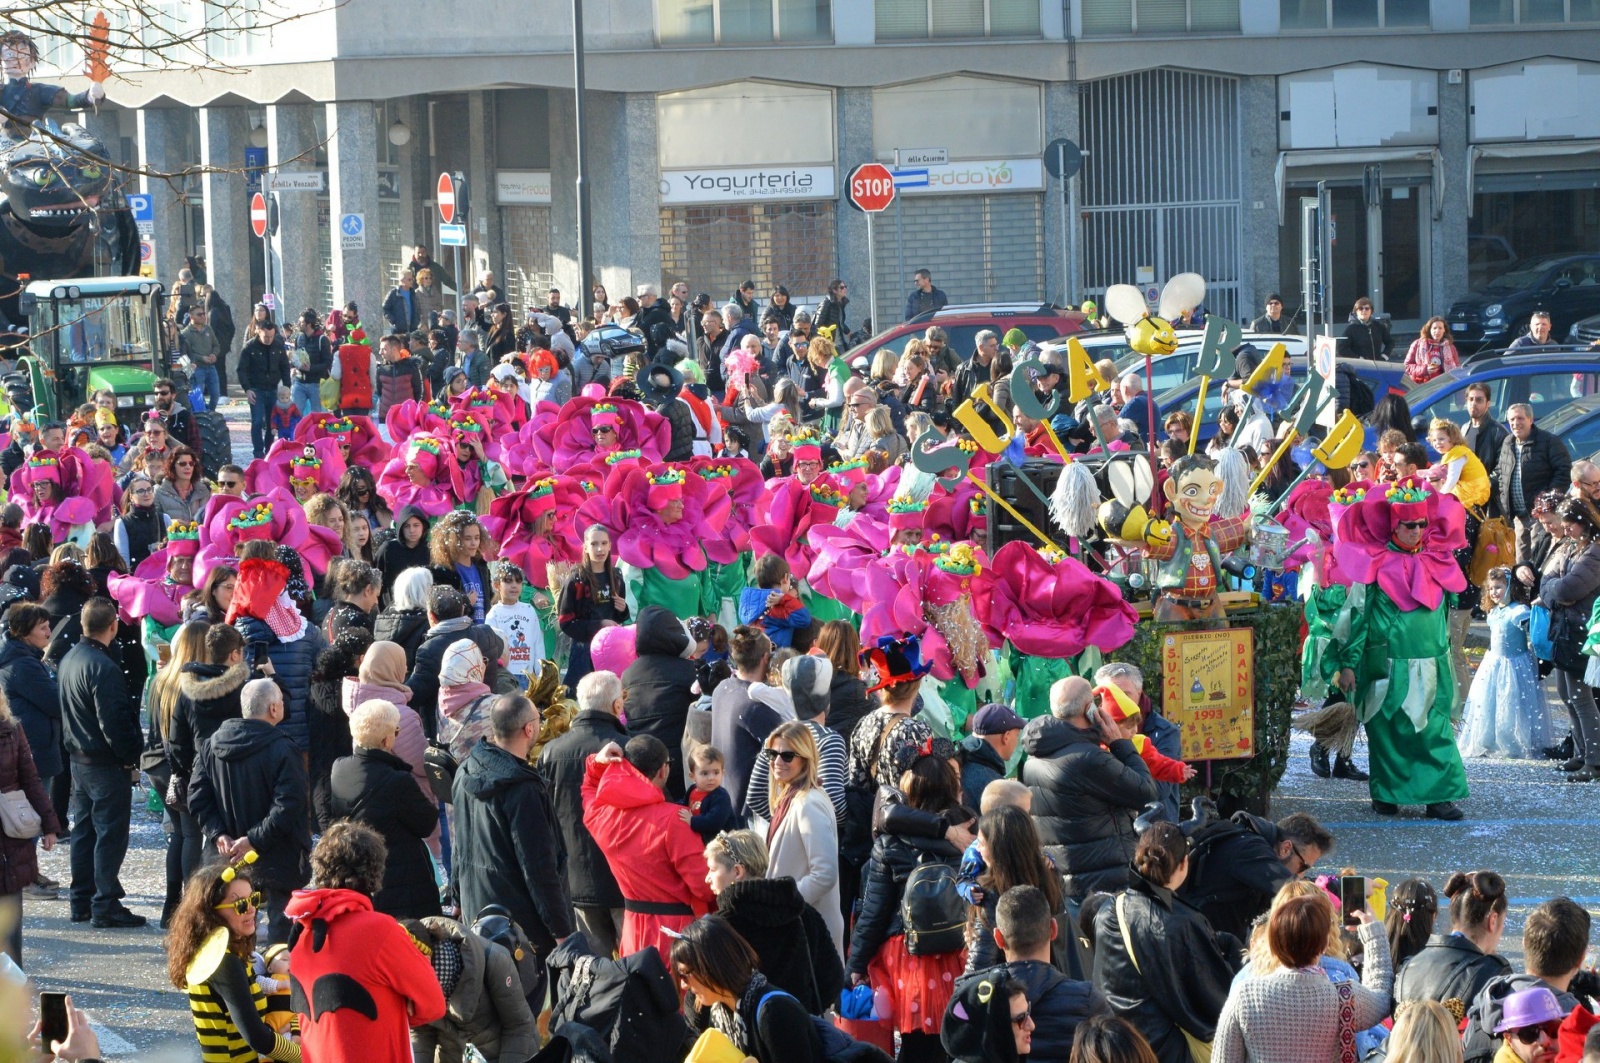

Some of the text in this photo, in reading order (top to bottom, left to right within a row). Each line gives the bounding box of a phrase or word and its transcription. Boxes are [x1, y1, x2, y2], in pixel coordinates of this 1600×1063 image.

[683, 171, 813, 192] Yogurteria
[854, 178, 892, 197] STOP
[130, 197, 148, 219] P
[1237, 643, 1248, 697] BAND
[1194, 709, 1223, 720] 1993
